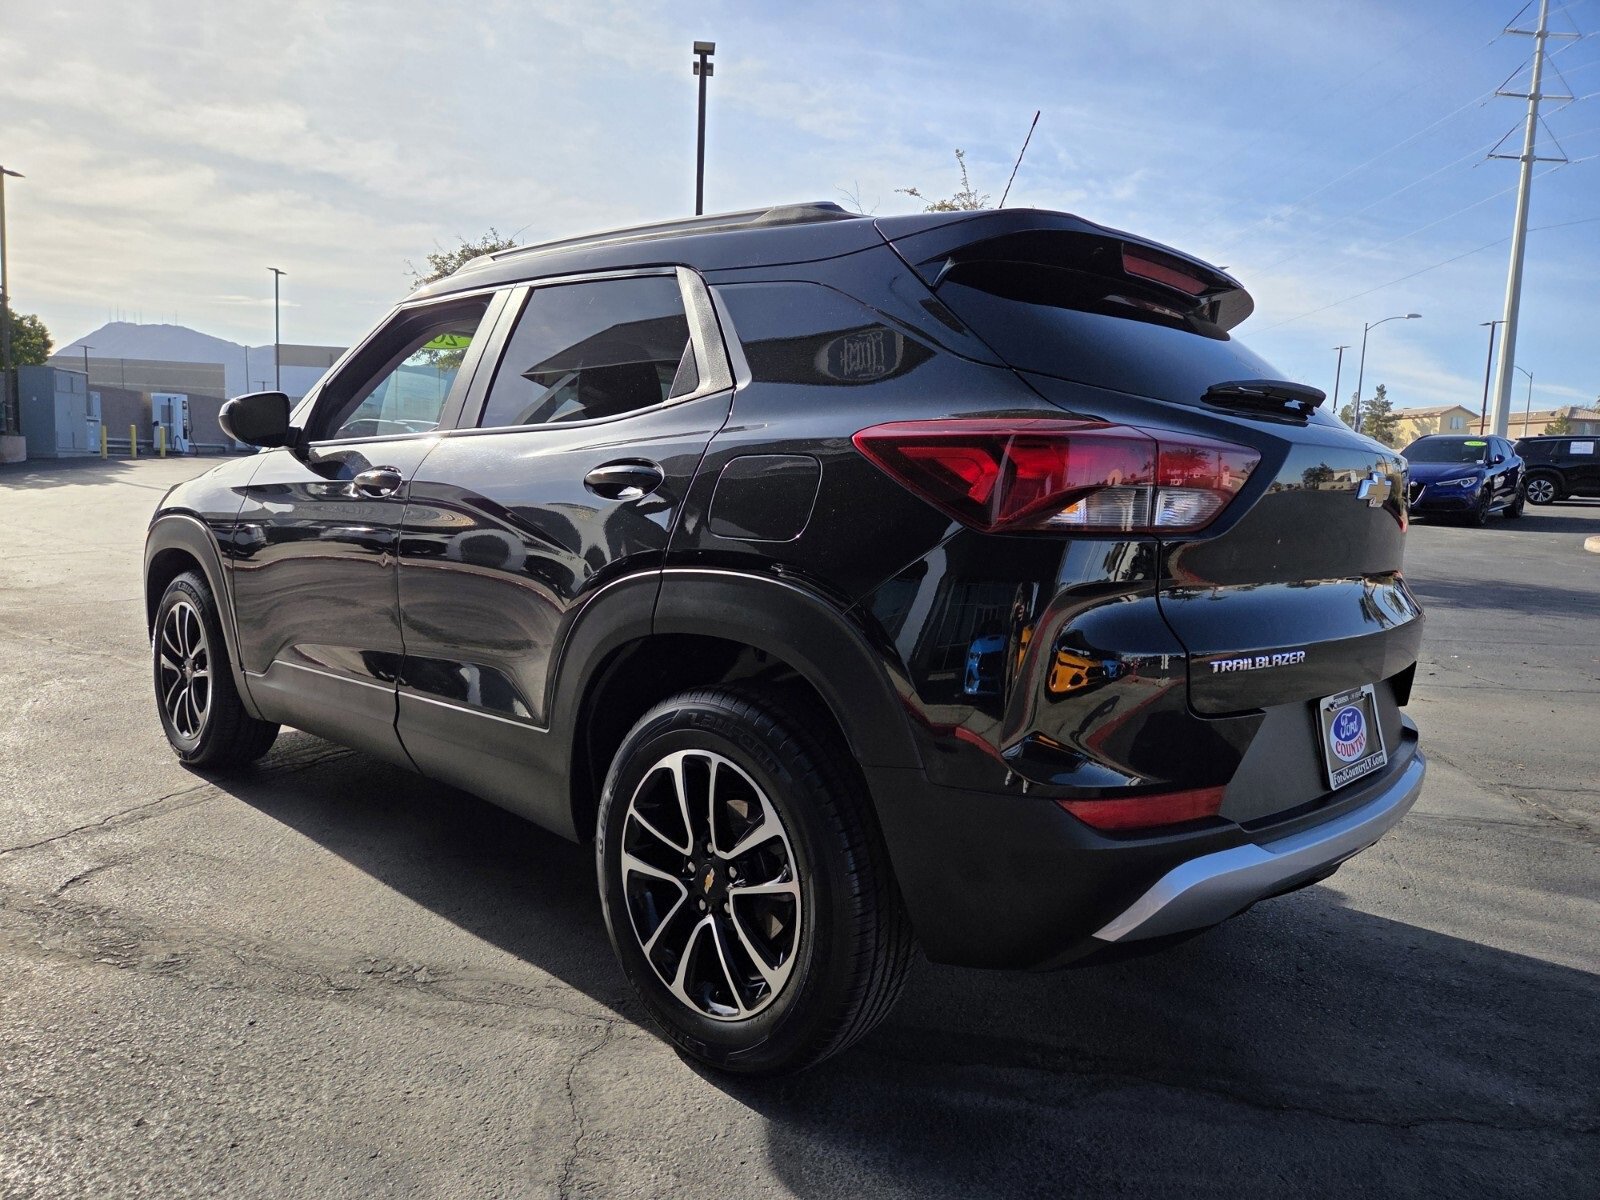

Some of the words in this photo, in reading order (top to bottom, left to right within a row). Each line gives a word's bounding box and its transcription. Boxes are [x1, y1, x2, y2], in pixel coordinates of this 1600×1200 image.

[1210, 651, 1306, 674] TRAILBLAZER
[1341, 711, 1359, 739] Ford
[1335, 732, 1366, 758] COUNTRY
